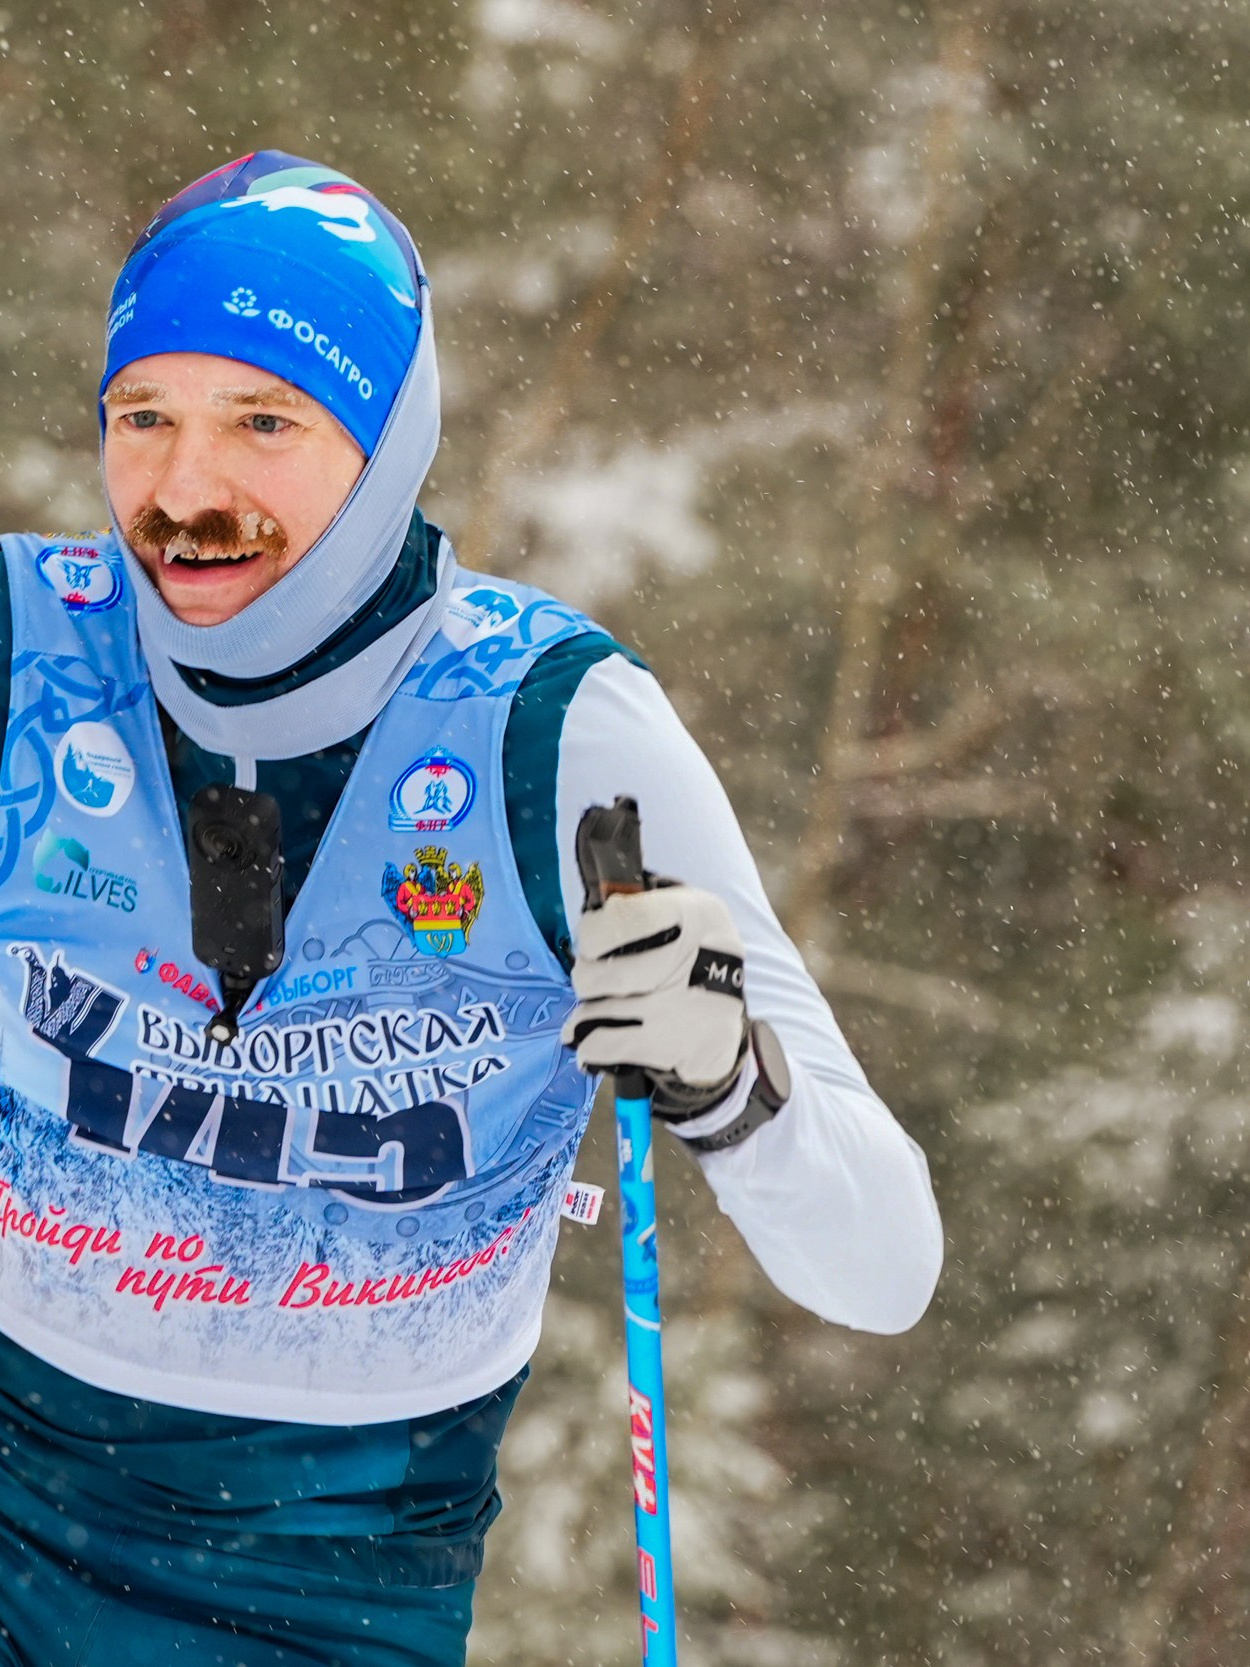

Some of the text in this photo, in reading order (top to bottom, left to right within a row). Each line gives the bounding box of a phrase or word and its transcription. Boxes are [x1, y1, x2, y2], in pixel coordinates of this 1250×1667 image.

[267, 308, 374, 401] ФОСАГРО
[63, 869, 139, 913] ILVES
[268, 966, 358, 1007] ВЫБОРГ
[140, 1004, 502, 1075] ВЫБОРГСКАЯ
[145, 1230, 206, 1263] по
[115, 1263, 252, 1311] пути
